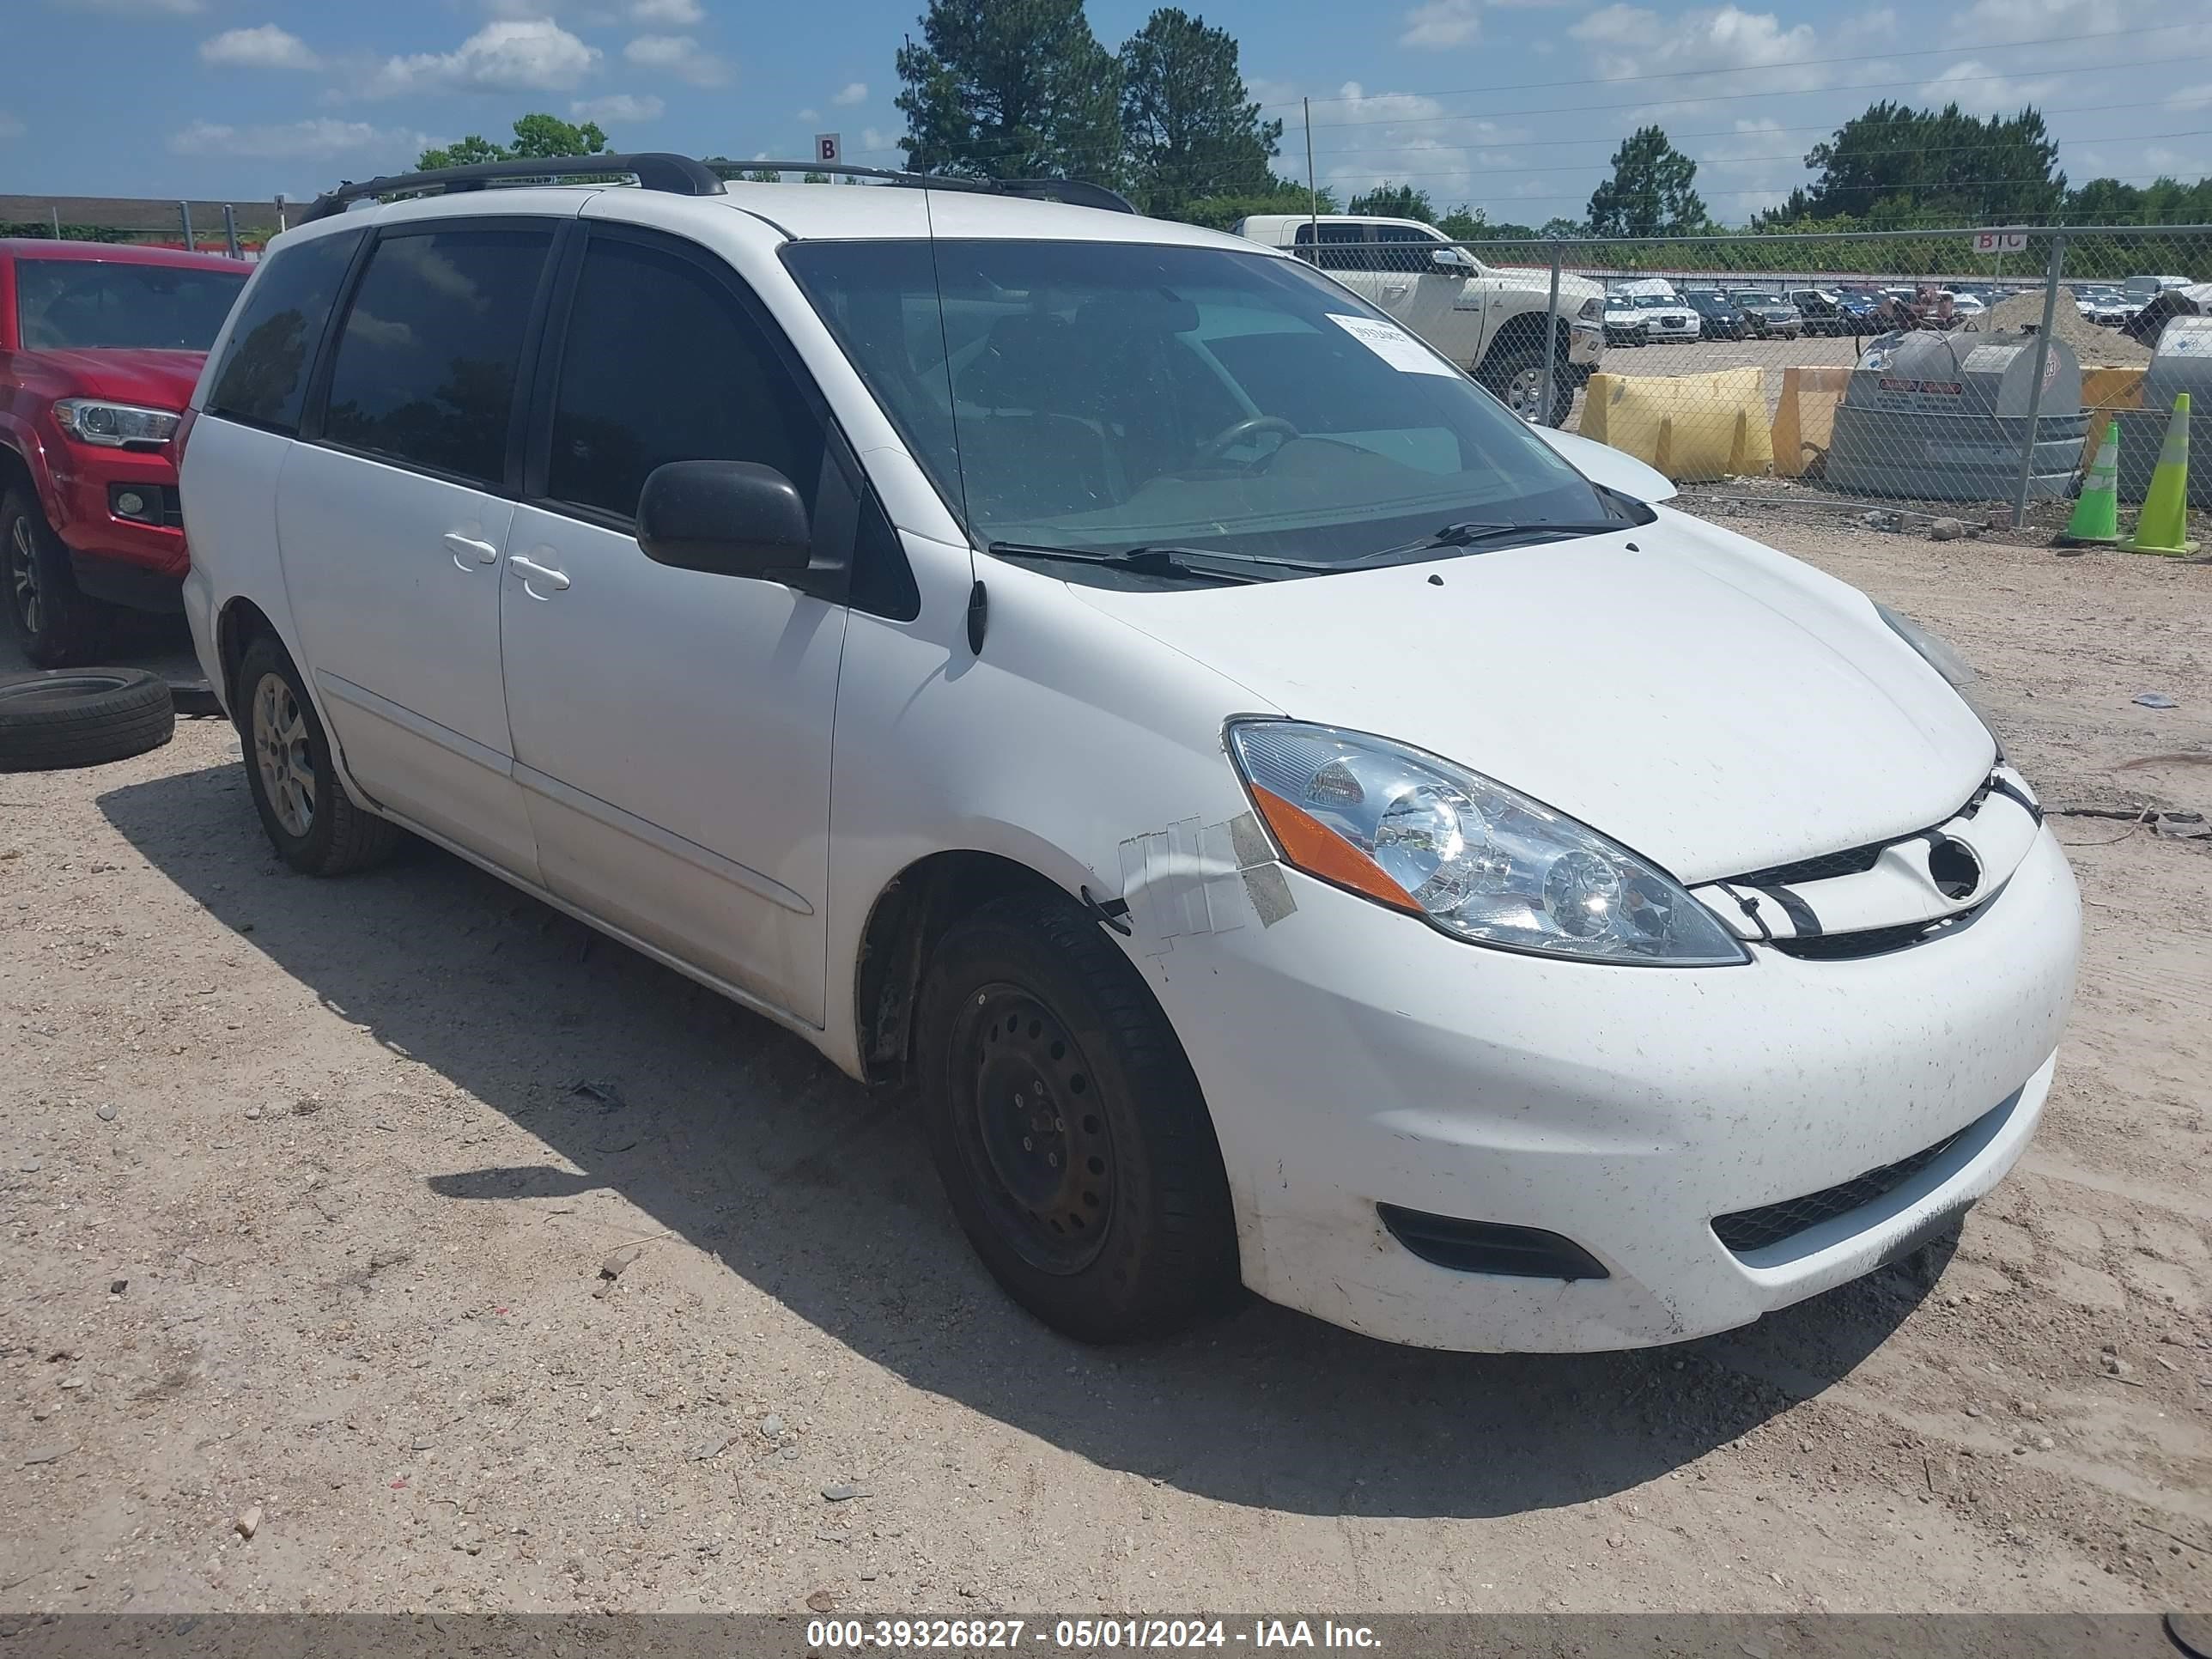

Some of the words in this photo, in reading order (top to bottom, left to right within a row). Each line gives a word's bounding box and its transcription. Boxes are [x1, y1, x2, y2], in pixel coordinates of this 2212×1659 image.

[823, 140, 835, 160] B
[276, 198, 283, 211] A
[2045, 362, 2055, 376] 03
